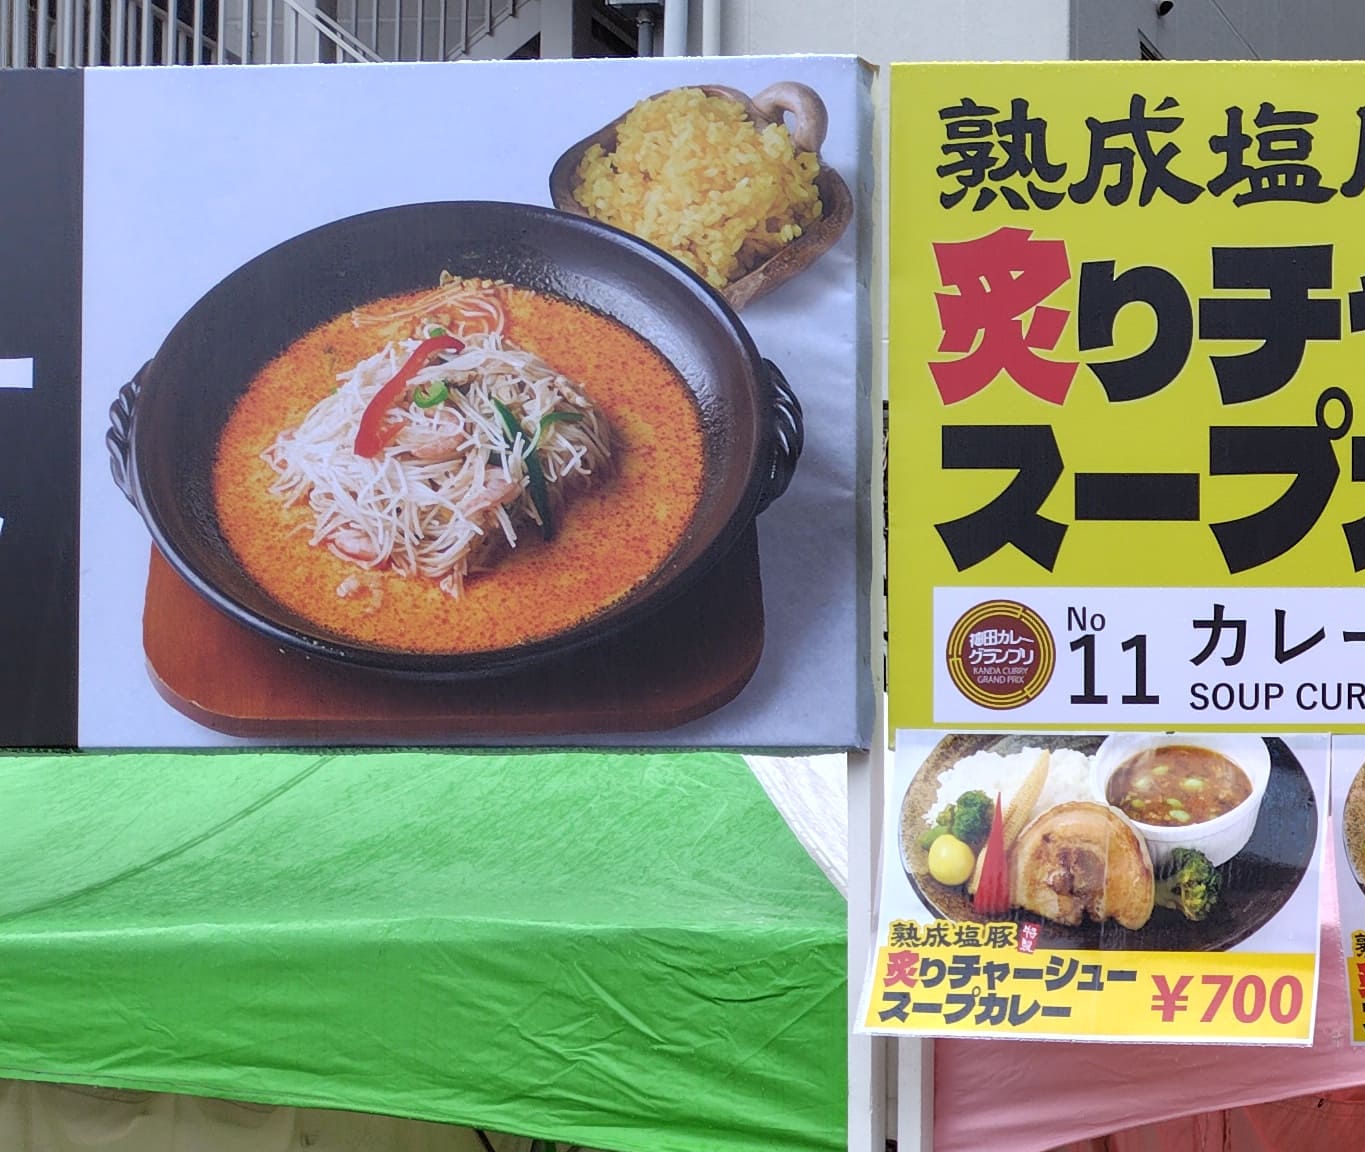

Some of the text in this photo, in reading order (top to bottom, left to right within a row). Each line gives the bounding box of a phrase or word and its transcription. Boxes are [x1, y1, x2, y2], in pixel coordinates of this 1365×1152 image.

[1067, 606, 1106, 632] No
[969, 629, 1035, 648] 神田カレー
[968, 647, 1034, 665] グランプリ
[1069, 634, 1160, 705] 11
[1189, 682, 1285, 711] SOUP
[891, 922, 1016, 949] 熟成塩豚
[883, 950, 1137, 995] 炙りチャーシュー
[879, 986, 1071, 1026] スープカレー
